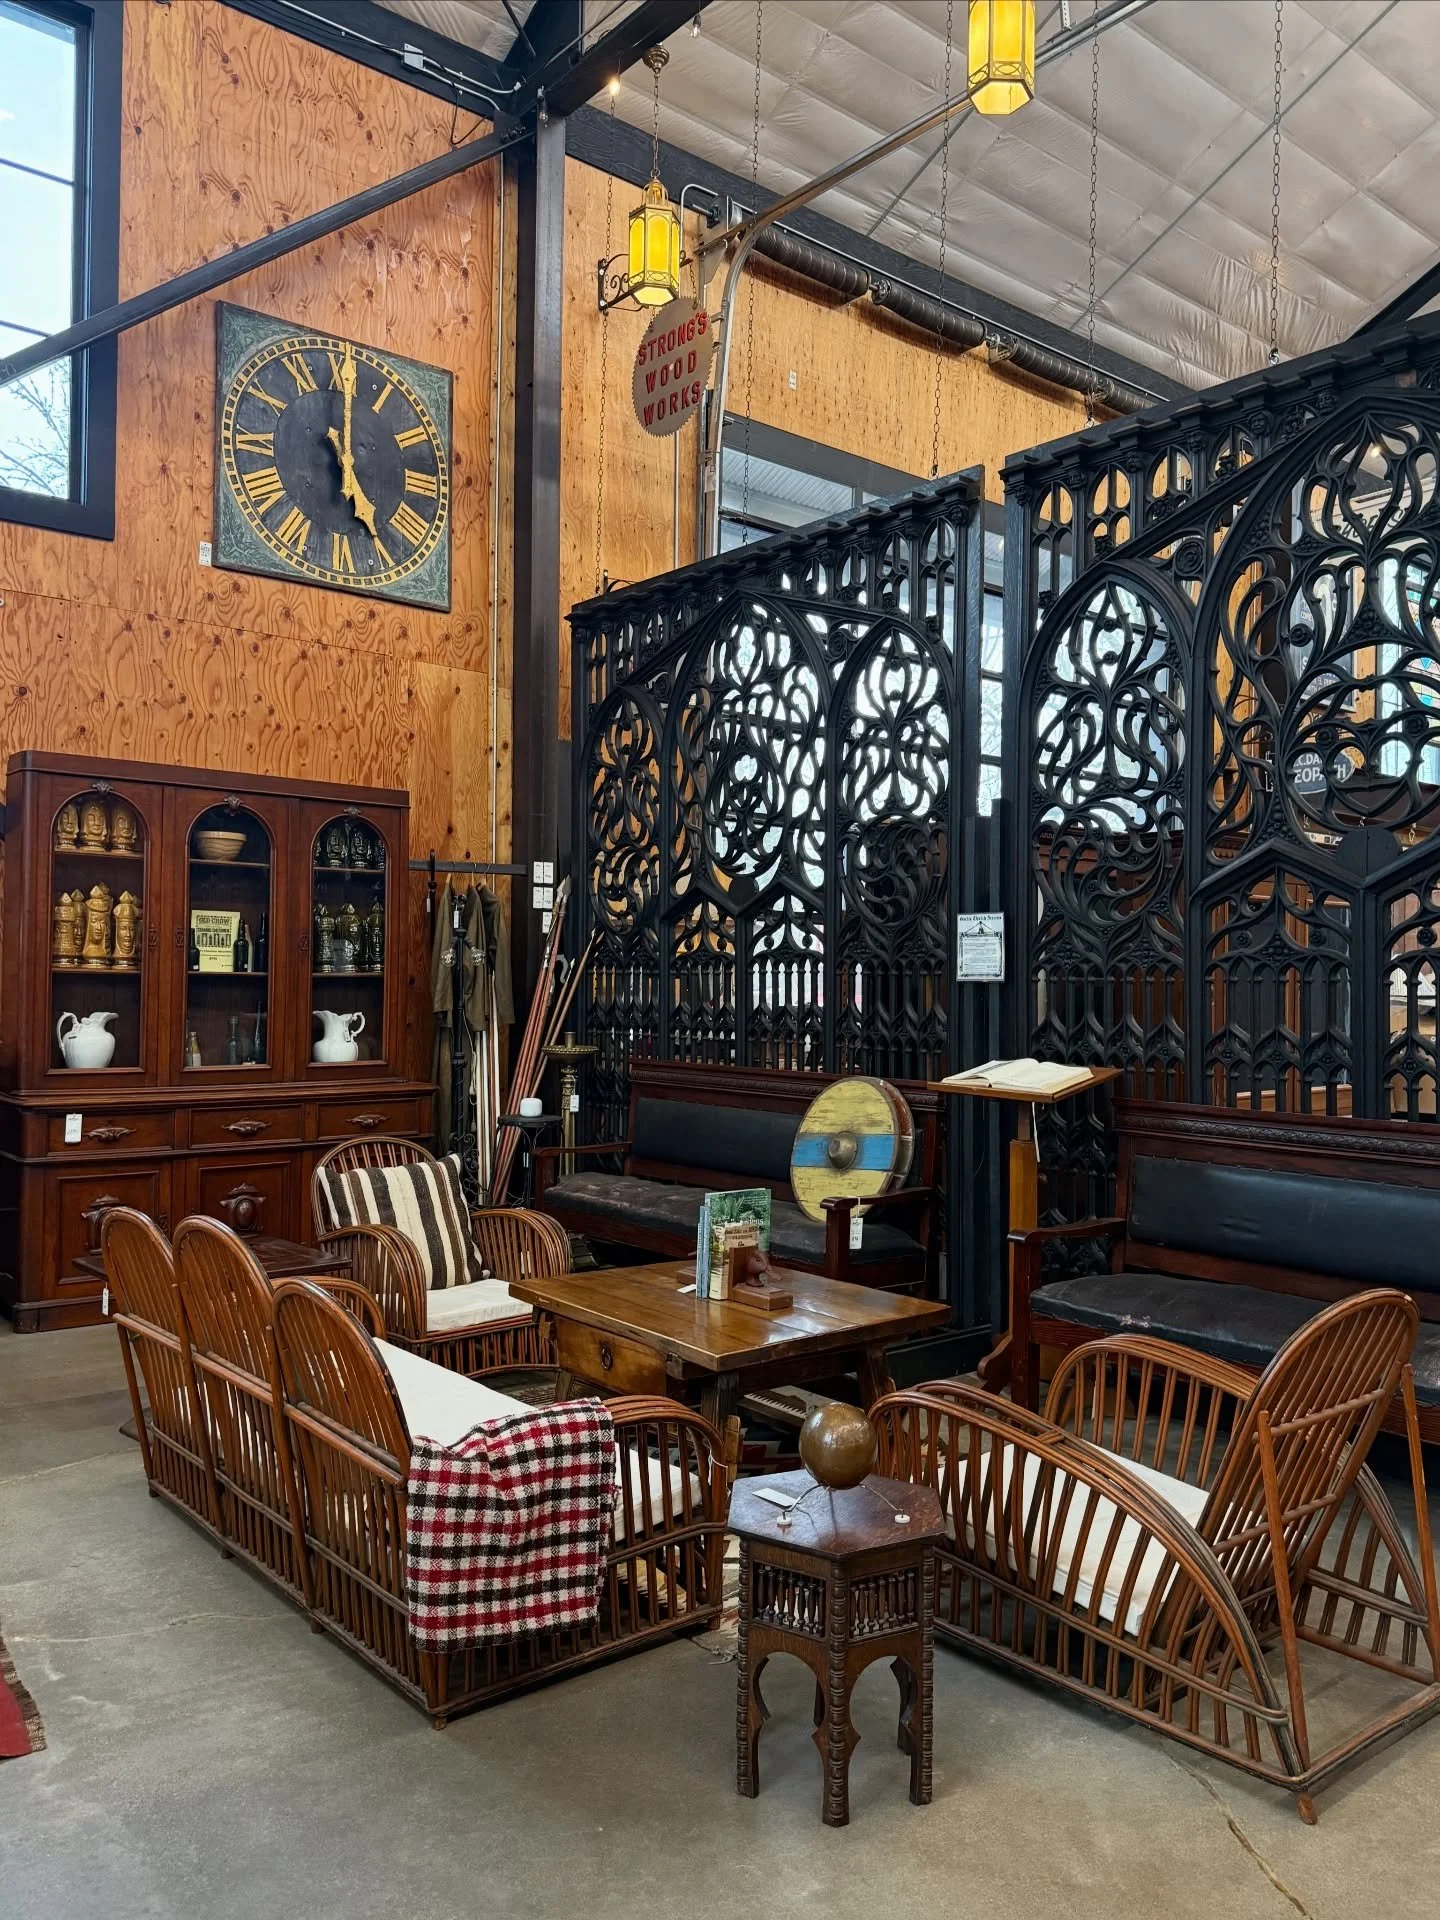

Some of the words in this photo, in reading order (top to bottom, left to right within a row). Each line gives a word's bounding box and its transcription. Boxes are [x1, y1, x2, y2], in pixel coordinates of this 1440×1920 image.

[638, 312, 708, 366] STRONG'S
[645, 350, 697, 394] WOOD
[643, 380, 702, 427] WORKS
